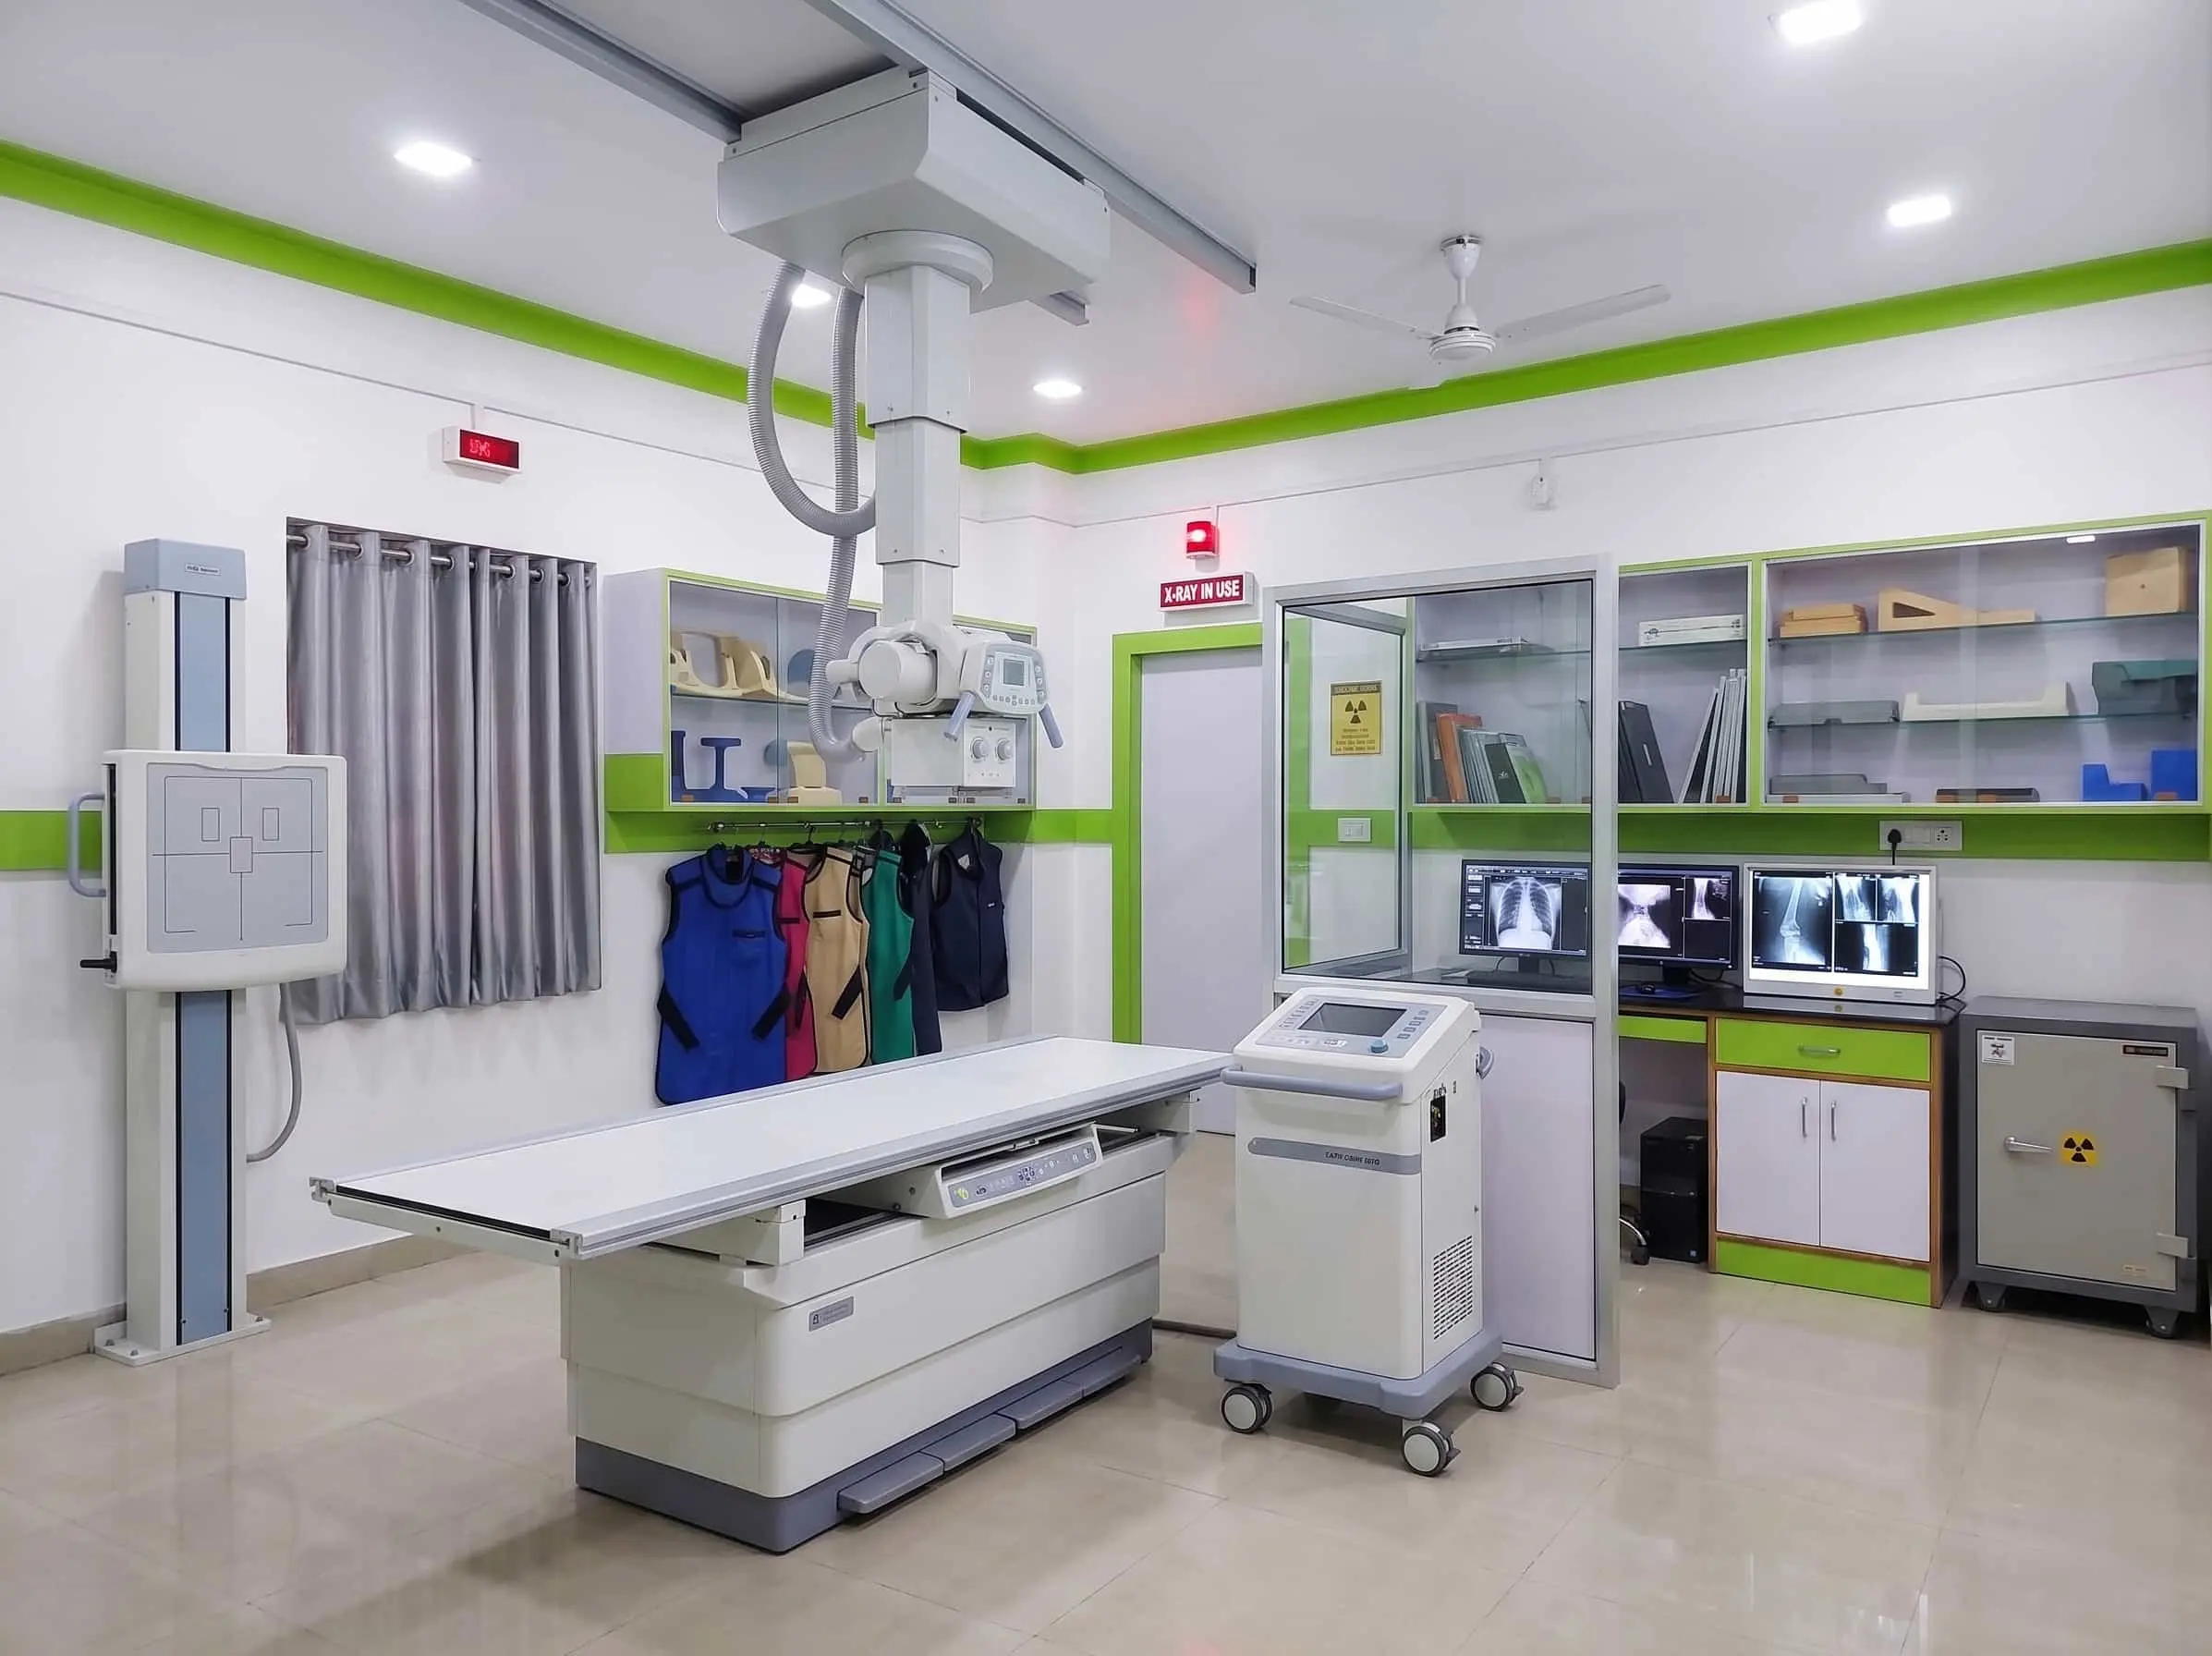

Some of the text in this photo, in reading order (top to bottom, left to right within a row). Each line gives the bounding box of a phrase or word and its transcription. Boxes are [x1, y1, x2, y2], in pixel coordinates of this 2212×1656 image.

[1164, 579, 1240, 603] X-RAY IN USE
